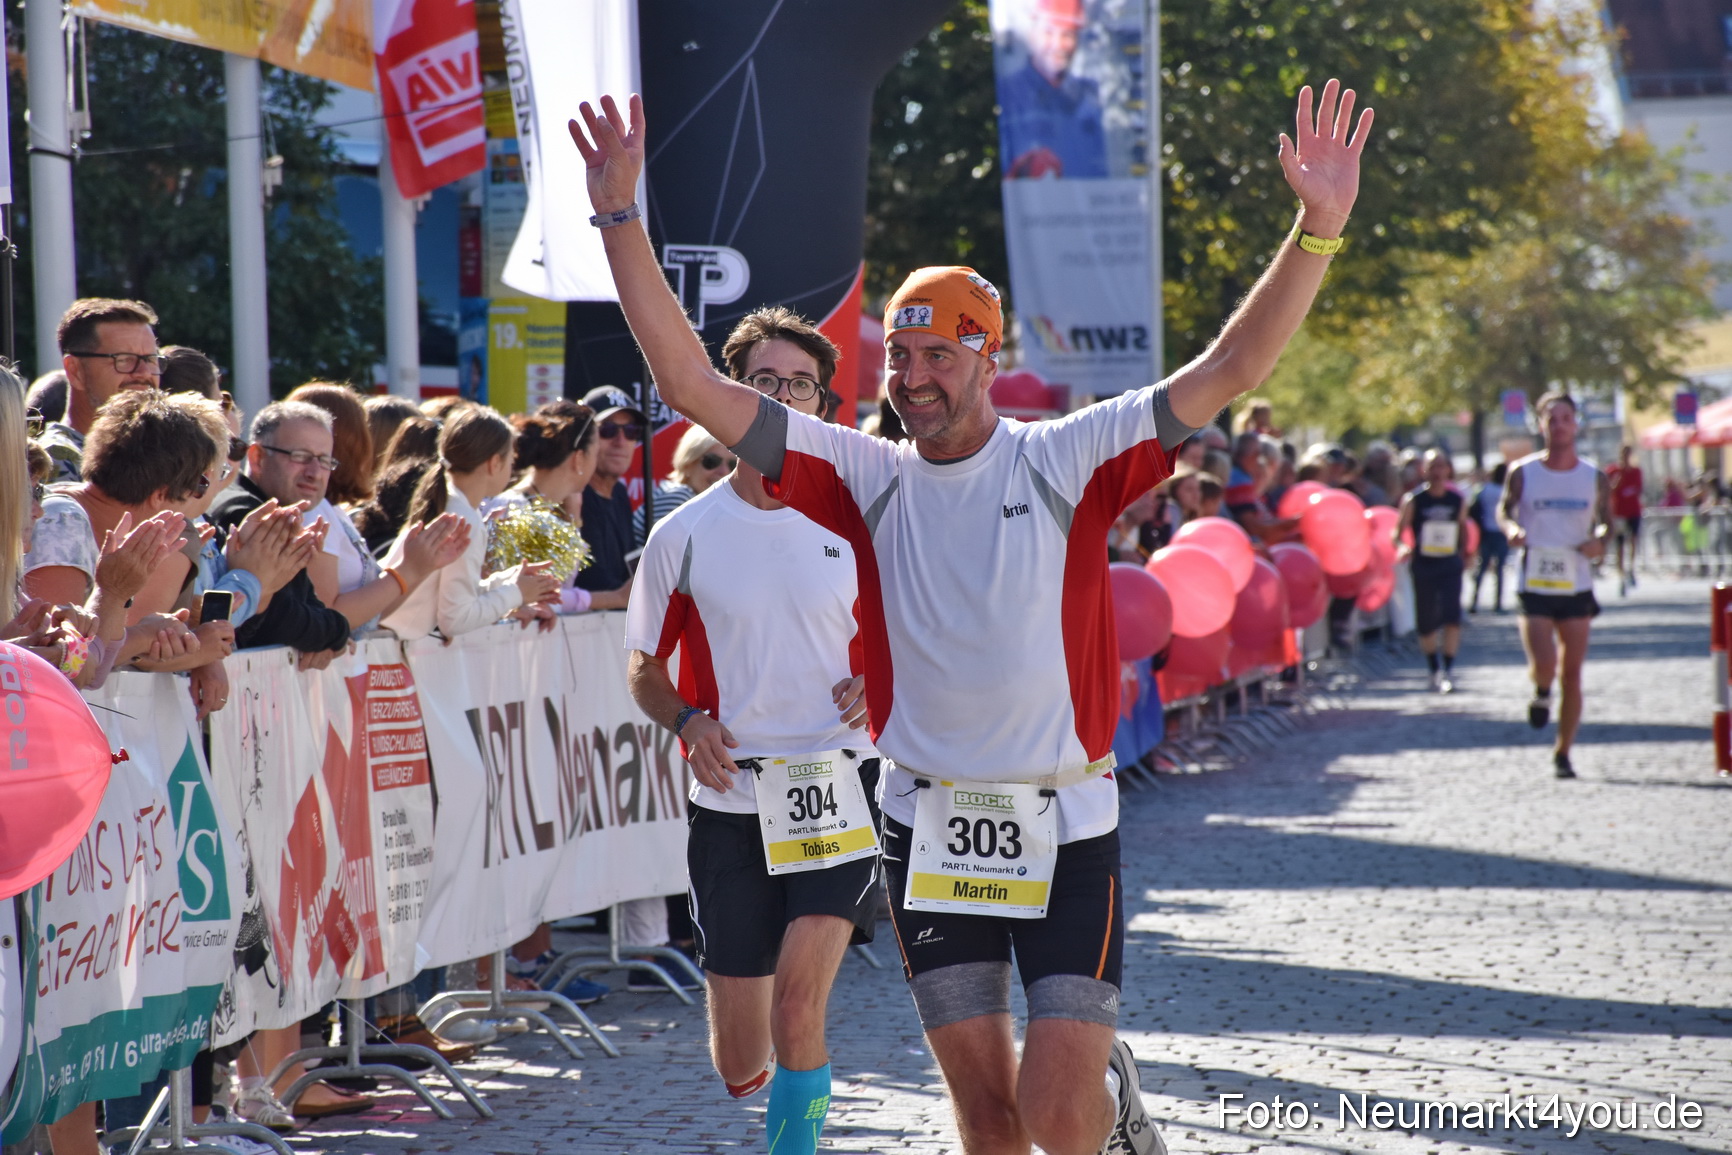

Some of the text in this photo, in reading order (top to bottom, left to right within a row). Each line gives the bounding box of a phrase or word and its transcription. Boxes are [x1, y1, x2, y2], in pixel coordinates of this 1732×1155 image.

[824, 545, 840, 558] Tobi
[788, 761, 833, 779] BOCK
[787, 782, 838, 822] 304
[954, 790, 1015, 809] BOCK
[788, 823, 837, 836] PARTL Neumarkt
[947, 816, 1023, 860] 303
[801, 841, 840, 857] Tobias
[919, 844, 926, 852] A
[941, 861, 1014, 875] PARTL Neumarkt
[953, 881, 1008, 900] Martin
